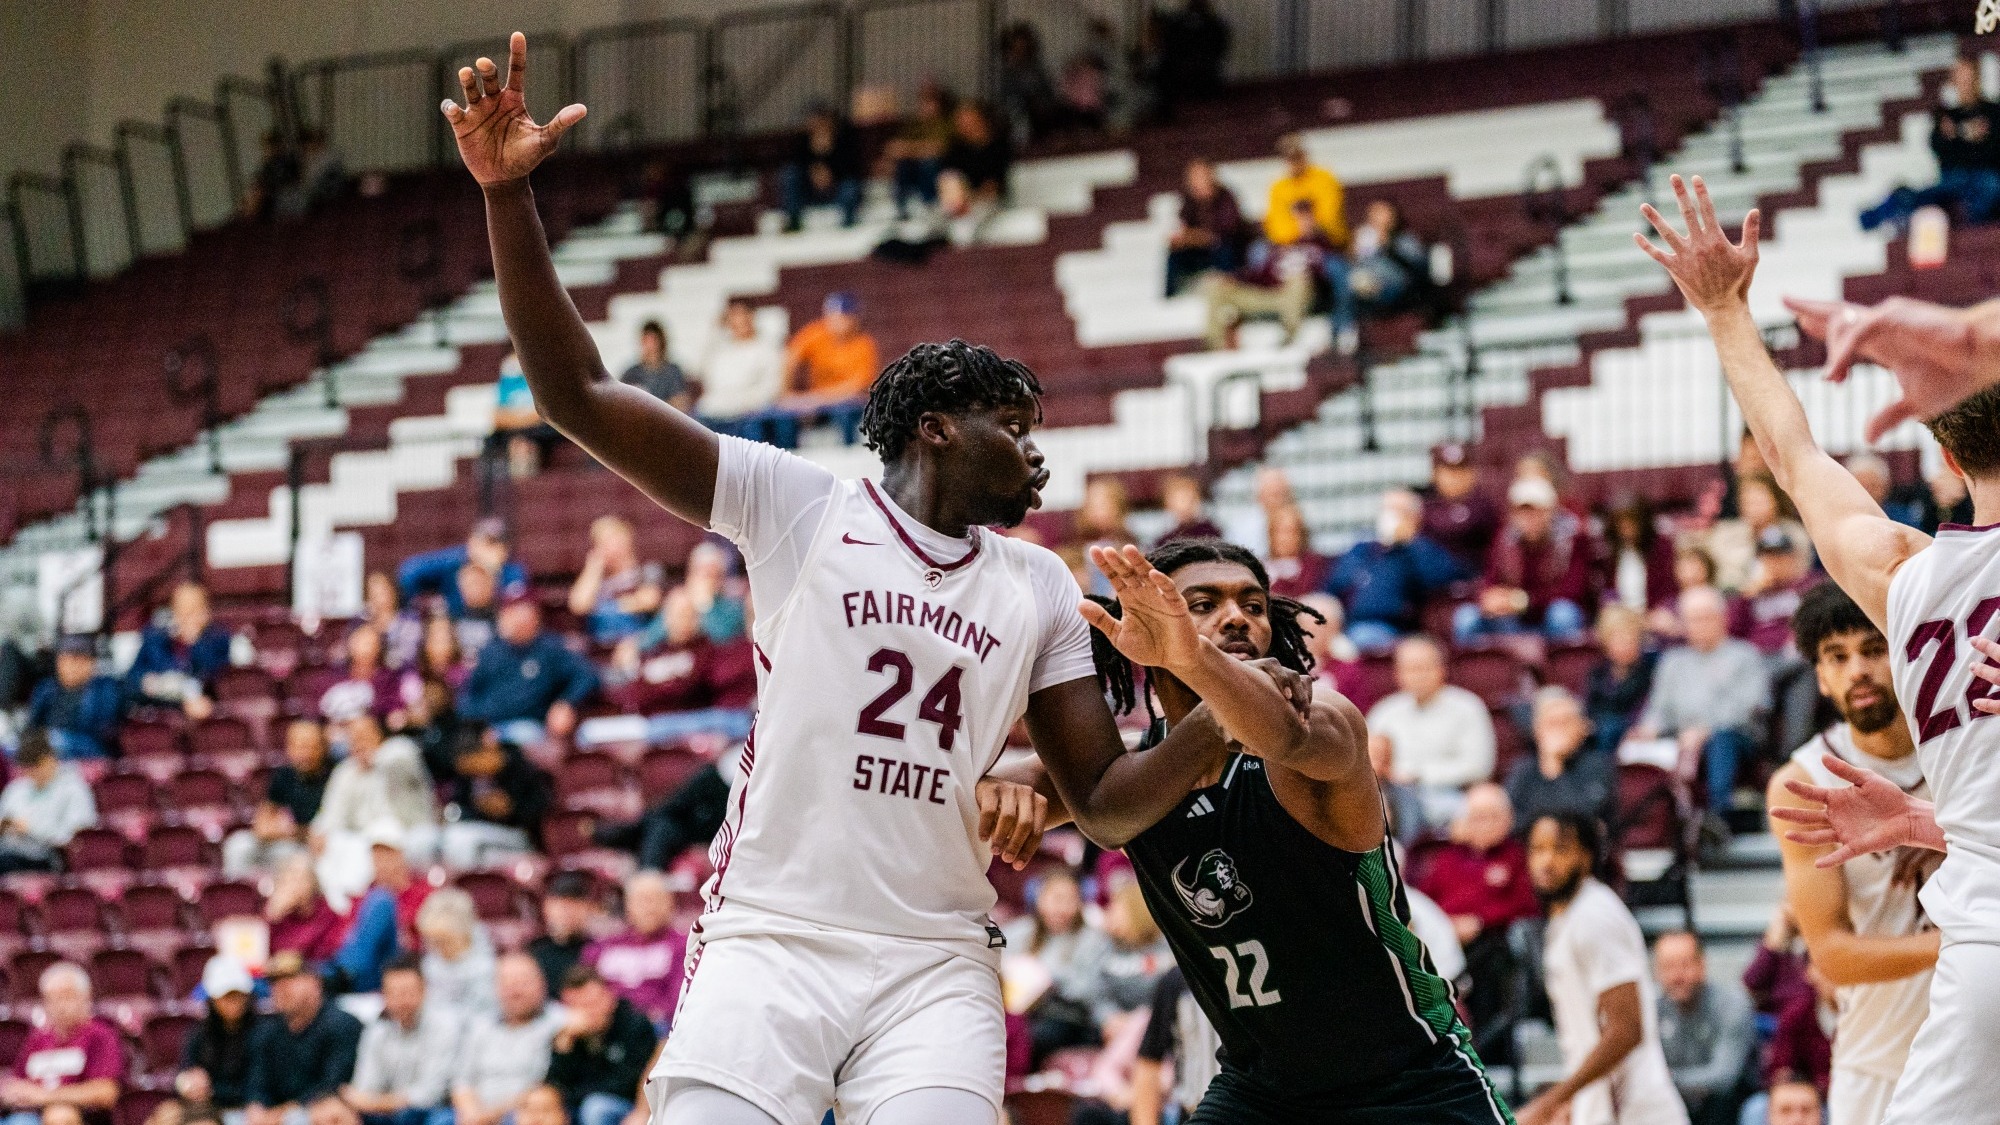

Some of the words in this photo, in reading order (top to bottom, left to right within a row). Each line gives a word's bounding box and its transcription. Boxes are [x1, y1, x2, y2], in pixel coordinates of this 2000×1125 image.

[842, 590, 1002, 663] FAIRMONT
[855, 645, 966, 754] 24
[853, 754, 950, 805] STATE
[1209, 939, 1282, 1009] 22
